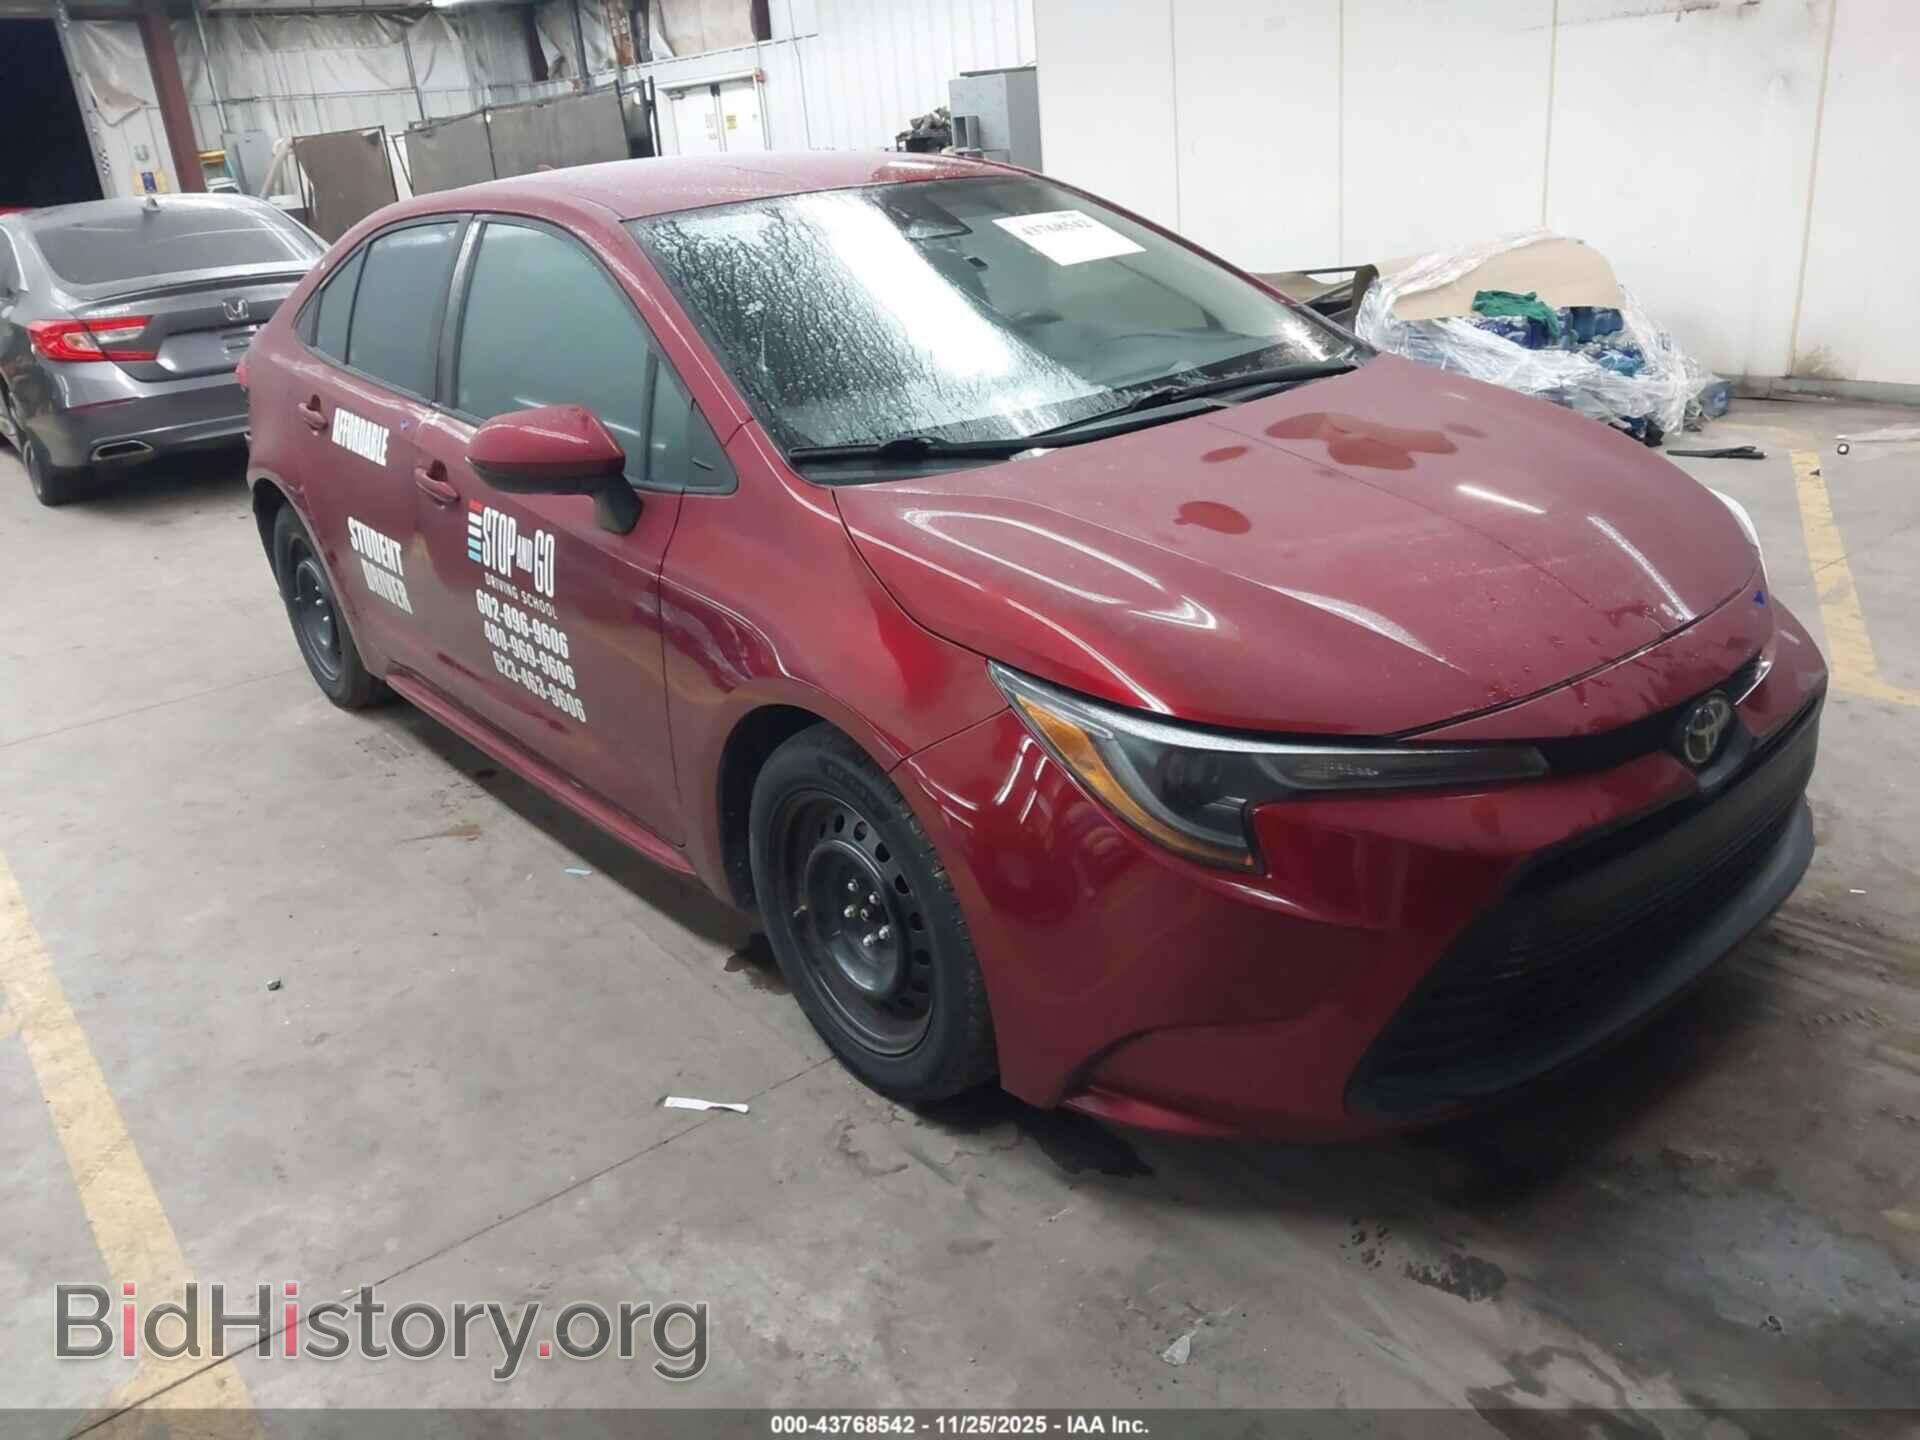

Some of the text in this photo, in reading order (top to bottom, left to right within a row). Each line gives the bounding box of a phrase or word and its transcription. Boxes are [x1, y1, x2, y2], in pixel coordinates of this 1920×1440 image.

[331, 407, 390, 467] AFFORDABLE
[347, 516, 404, 576] STUDENT
[482, 506, 555, 598] STOP AND GO
[360, 558, 414, 615] DRIVER
[484, 571, 559, 620] DRIVING SCHOOL
[475, 588, 569, 659] 602-896-9606
[484, 620, 576, 690] 480-969-9606
